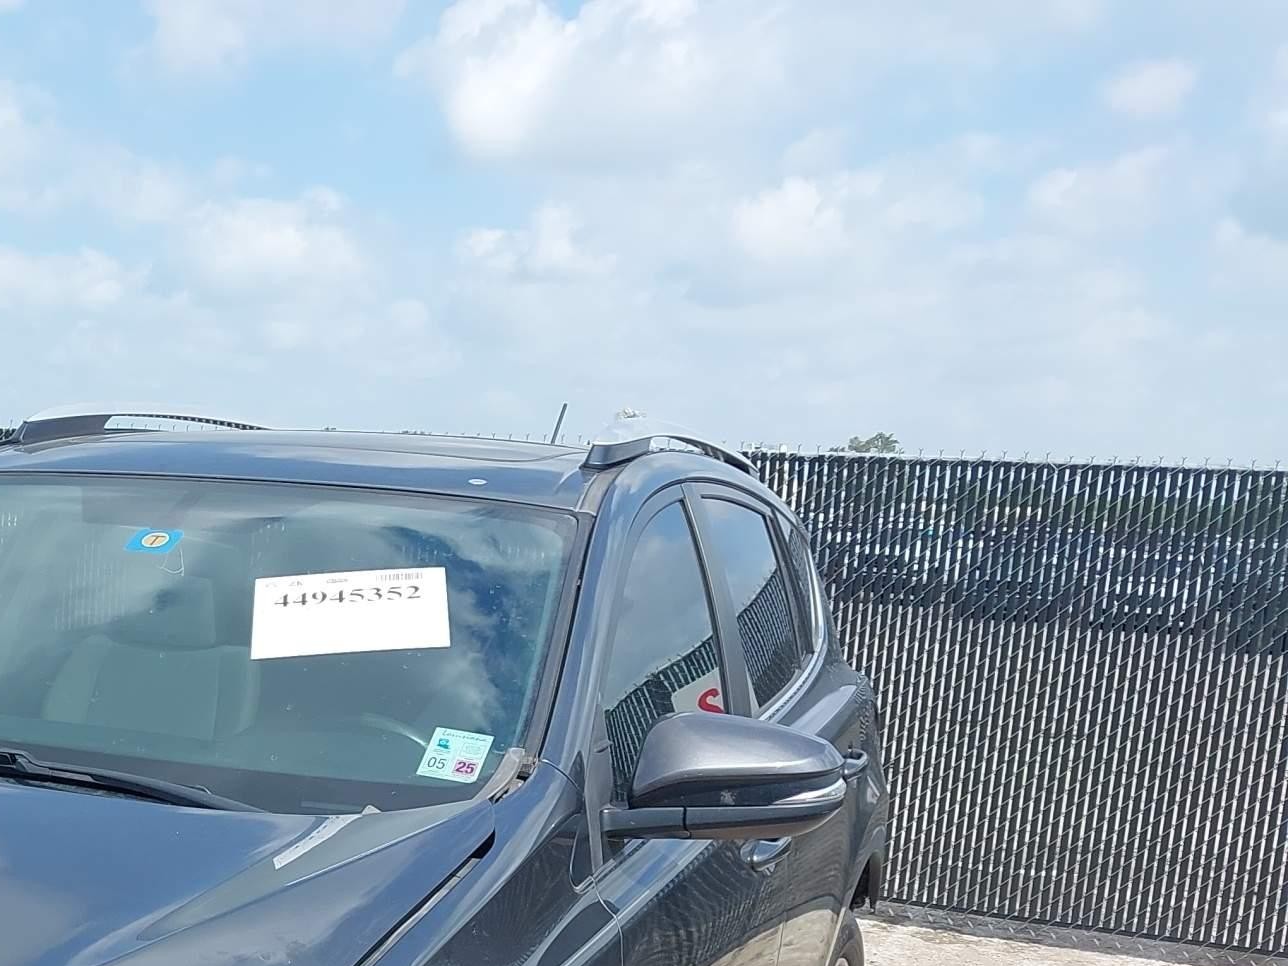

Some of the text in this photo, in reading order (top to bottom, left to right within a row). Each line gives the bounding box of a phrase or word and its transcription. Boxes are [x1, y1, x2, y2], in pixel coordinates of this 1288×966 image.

[273, 584, 422, 607] 44945352
[427, 756, 477, 775] 05 25
